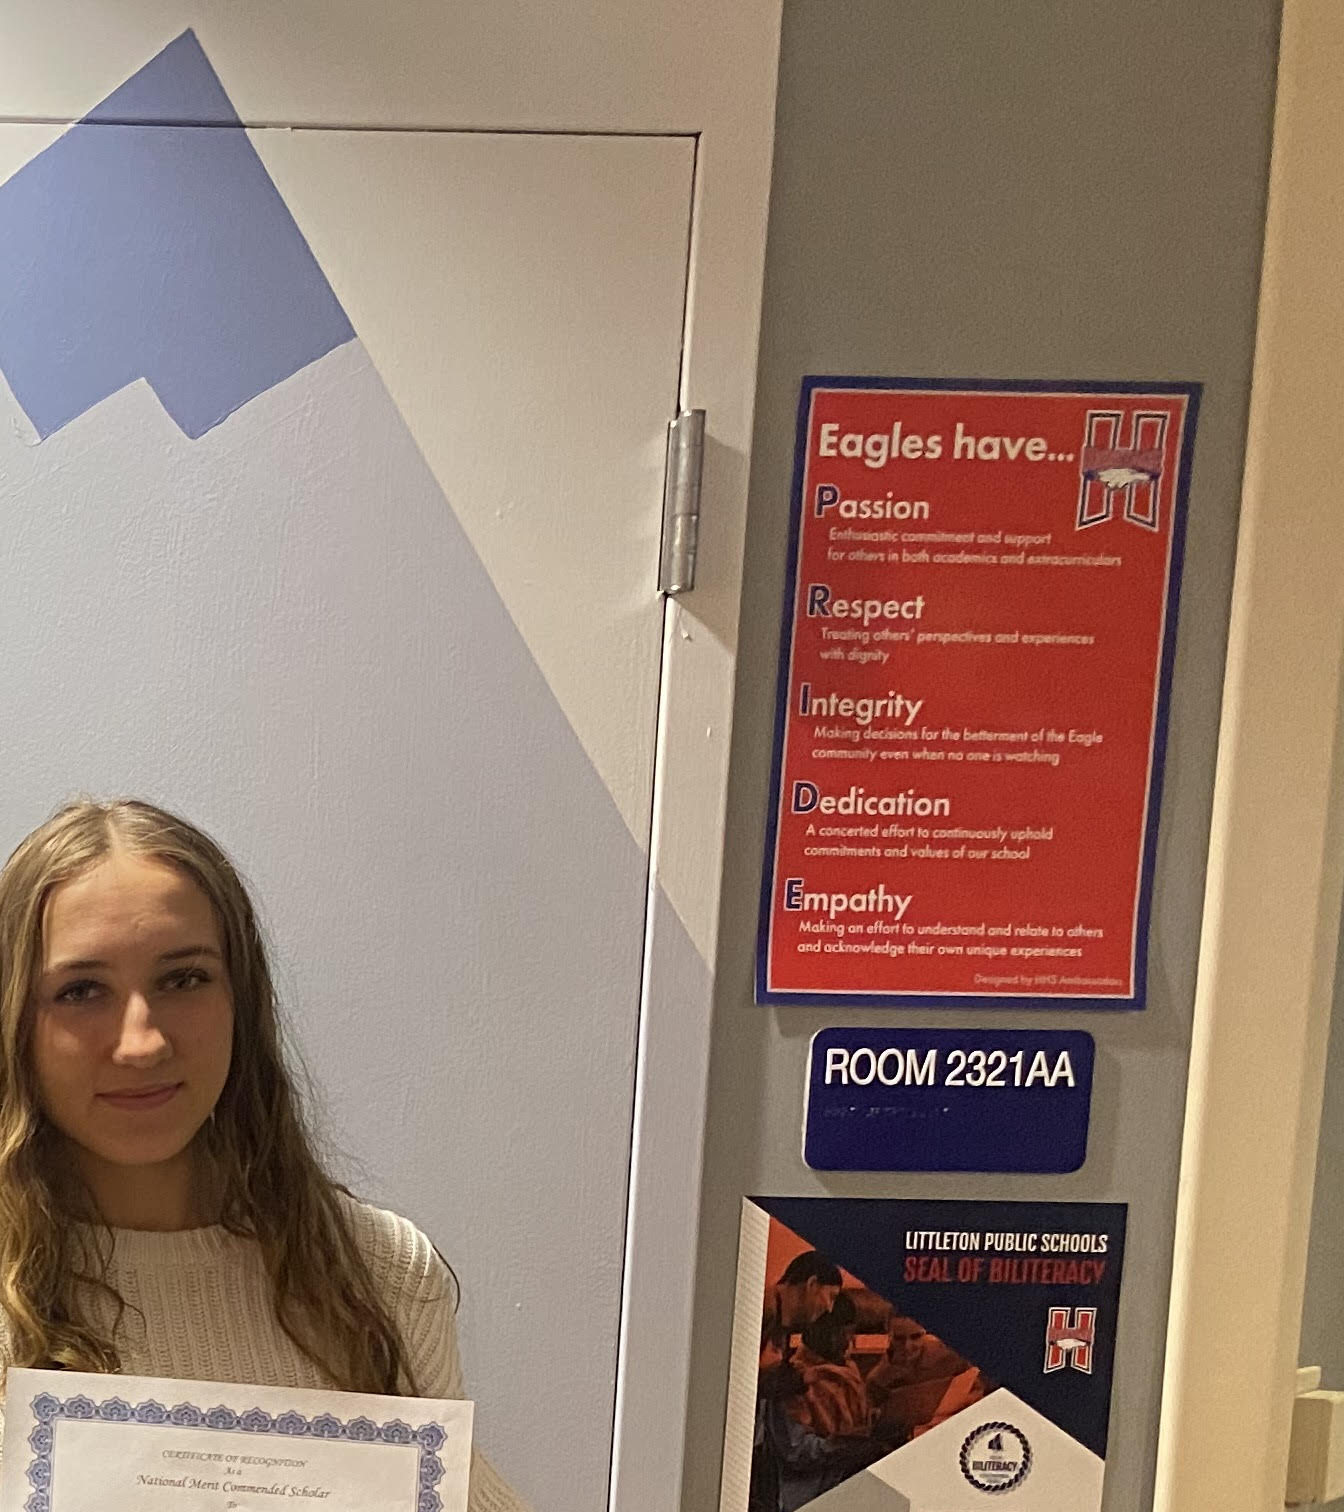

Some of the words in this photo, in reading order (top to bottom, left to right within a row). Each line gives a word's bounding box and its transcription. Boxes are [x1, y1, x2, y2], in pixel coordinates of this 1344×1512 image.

[819, 422, 942, 468] Eagles
[954, 423, 1073, 462] have...
[814, 483, 929, 520] Passion
[829, 529, 899, 542] Enthusiastic
[901, 530, 974, 543] commitment
[977, 532, 1002, 544] and
[1004, 532, 1052, 548] support
[827, 550, 845, 561] for
[848, 550, 885, 562] others
[888, 551, 900, 562] in
[902, 551, 929, 562] both
[933, 551, 997, 564] academics
[1000, 552, 1025, 564] and
[1028, 553, 1122, 565] extracurriculars
[808, 584, 924, 625] Respect
[821, 629, 870, 645] Treating
[916, 630, 992, 647] perspectives
[994, 632, 1019, 643] and
[1022, 632, 1096, 648] experiences
[819, 648, 845, 660] with
[848, 649, 890, 665] dignity
[800, 683, 922, 725] Integrity
[813, 728, 860, 743] Making
[863, 728, 917, 740] decisions
[920, 729, 939, 741] for
[941, 729, 960, 741] the
[963, 730, 1028, 742] betterment
[1031, 731, 1045, 742] of
[1046, 731, 1066, 742] the
[1068, 731, 1104, 746] Eagle
[812, 747, 878, 763] community
[880, 751, 909, 760] even
[912, 749, 945, 760] when
[948, 752, 964, 761] no
[966, 752, 991, 761] one
[993, 751, 1003, 761] is
[1005, 751, 1060, 766] watching
[792, 780, 950, 815] Dedication
[806, 824, 816, 836] A
[819, 825, 878, 837] concerted
[881, 826, 916, 838] effort
[918, 826, 929, 838] to
[933, 827, 1009, 843] continuously
[1011, 828, 1054, 844] uphold
[804, 844, 881, 857] commitments
[884, 845, 909, 857] and
[911, 846, 950, 858] values
[952, 846, 966, 858] of
[968, 850, 989, 859] our
[991, 847, 1031, 859] school
[784, 878, 912, 918] Empathy
[799, 921, 845, 937] Making
[848, 925, 864, 934] an
[866, 922, 900, 934] effort
[902, 923, 914, 935] to
[918, 923, 984, 936] understand
[987, 924, 1012, 936] and
[1015, 924, 1050, 936] relate
[1052, 925, 1064, 937] to
[1067, 925, 1104, 937] others
[798, 941, 821, 953] and
[824, 941, 905, 958] acknowledge
[907, 942, 934, 955] their
[938, 947, 964, 955] own
[966, 943, 1008, 959] unique
[1010, 944, 1082, 961] experiences
[824, 1048, 937, 1086] ROOM
[945, 1050, 1075, 1087] 2321AA
[906, 1231, 980, 1251] LITTLETON
[984, 1232, 1037, 1252] PUBLIC
[1041, 1233, 1108, 1253] SCHOOLS
[904, 1257, 955, 1282] SEAL
[958, 1258, 982, 1283] OF
[989, 1259, 1106, 1285] BILITERACY
[137, 1475, 187, 1488] National
[188, 1478, 219, 1490] Merit
[222, 1481, 287, 1496] Commended
[288, 1485, 330, 1499] Scholar
